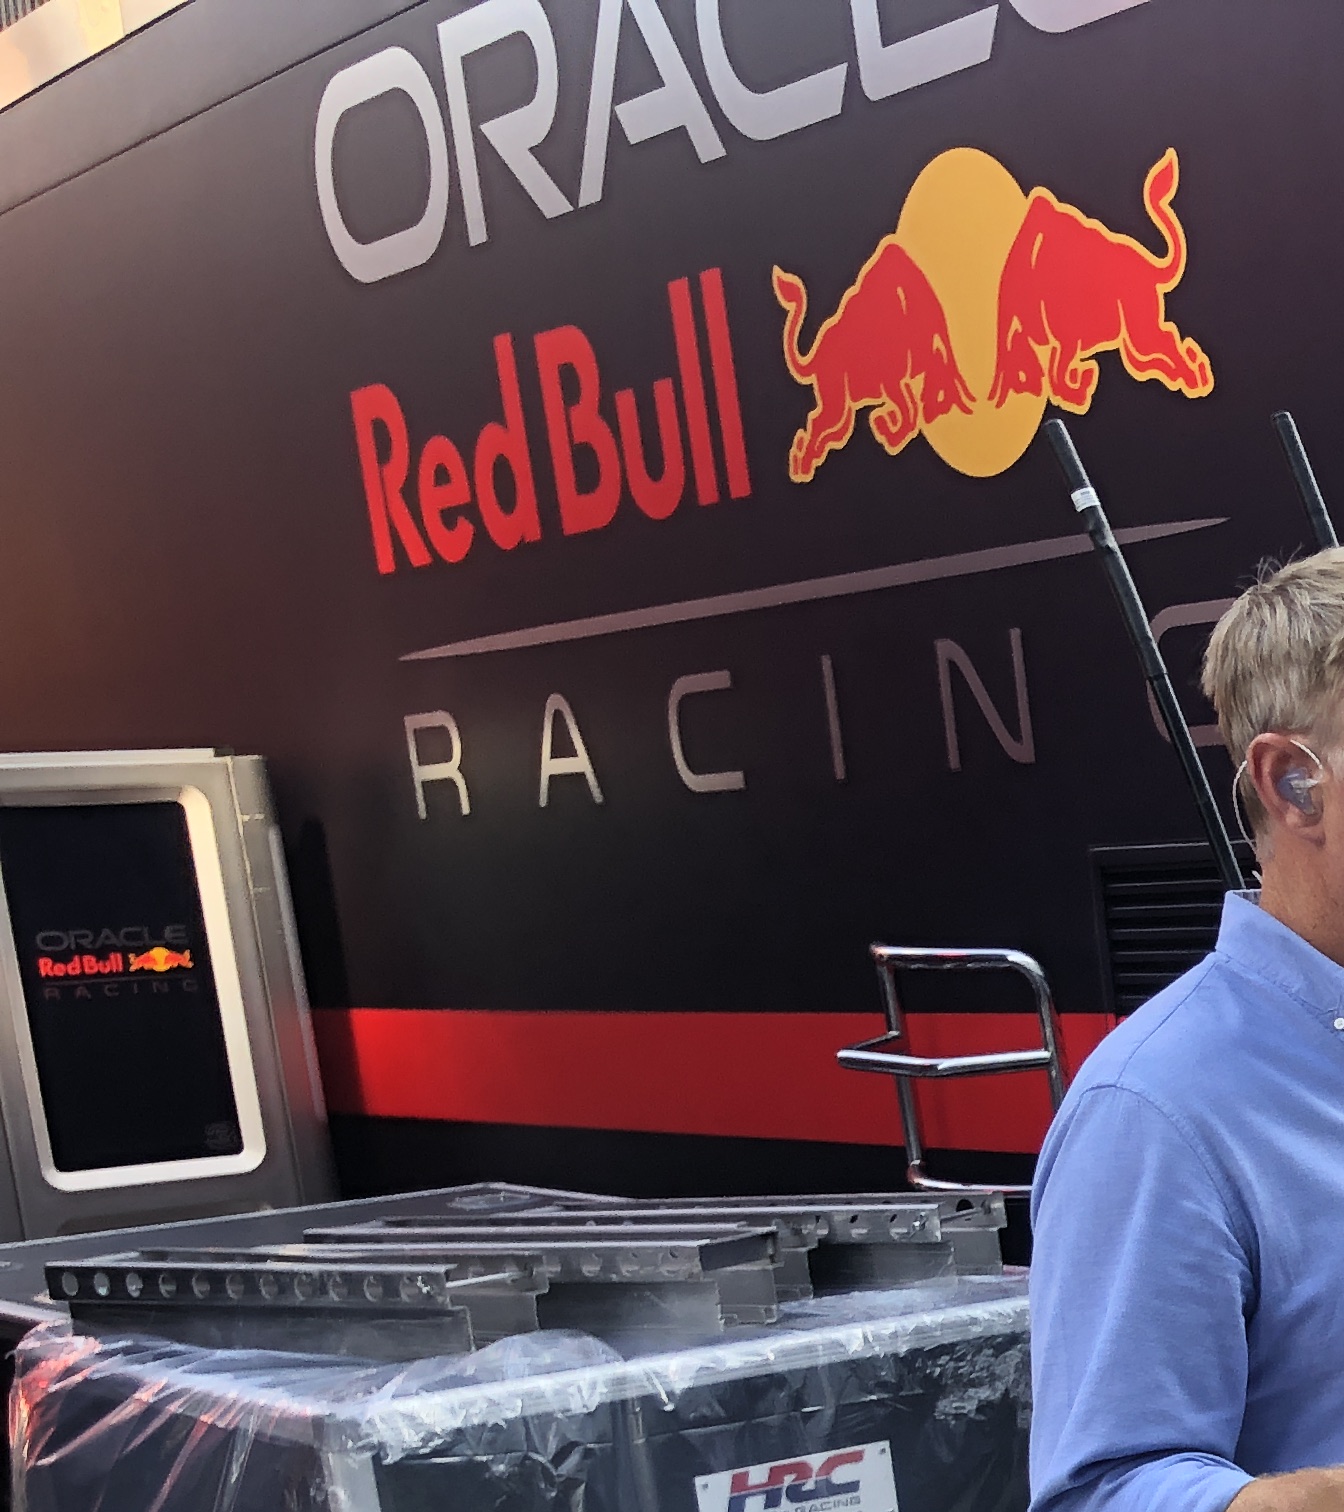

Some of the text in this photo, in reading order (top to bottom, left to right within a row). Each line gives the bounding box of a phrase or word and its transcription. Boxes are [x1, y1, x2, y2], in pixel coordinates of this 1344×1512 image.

[314, 0, 1148, 282] ORAC
[35, 925, 190, 951] ORACLE
[44, 979, 199, 1000] RACING
